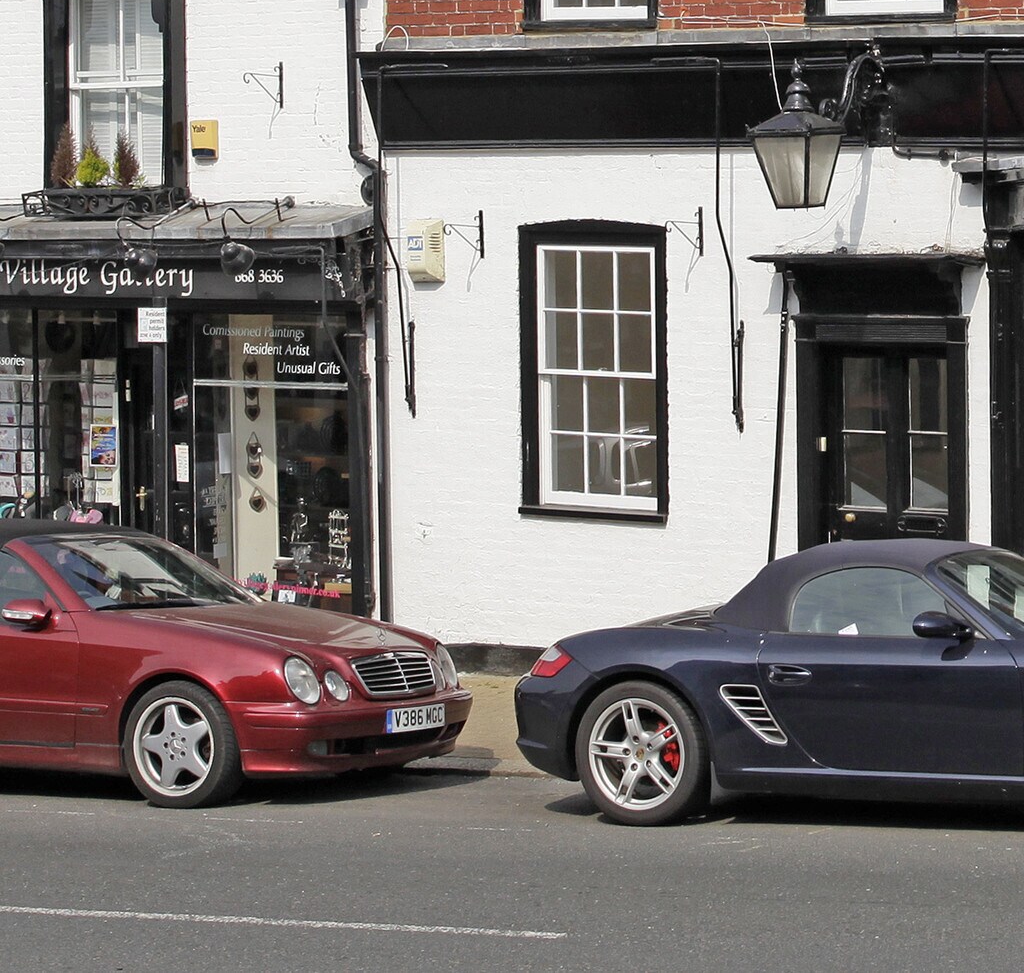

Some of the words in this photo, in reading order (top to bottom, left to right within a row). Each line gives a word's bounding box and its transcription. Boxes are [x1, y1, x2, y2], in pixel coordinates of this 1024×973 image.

[192, 124, 206, 133] Yale
[0, 259, 91, 294] Village
[100, 260, 194, 297] Gaery
[258, 269, 284, 283] 3636
[202, 323, 262, 337] Comissioned
[264, 327, 305, 342] Paintings
[242, 342, 283, 356] Resident
[284, 344, 310, 357] Artist
[276, 361, 316, 375] Unusual
[318, 362, 341, 375] Gifts
[394, 710, 424, 728] V386
[426, 707, 443, 724] MGC
